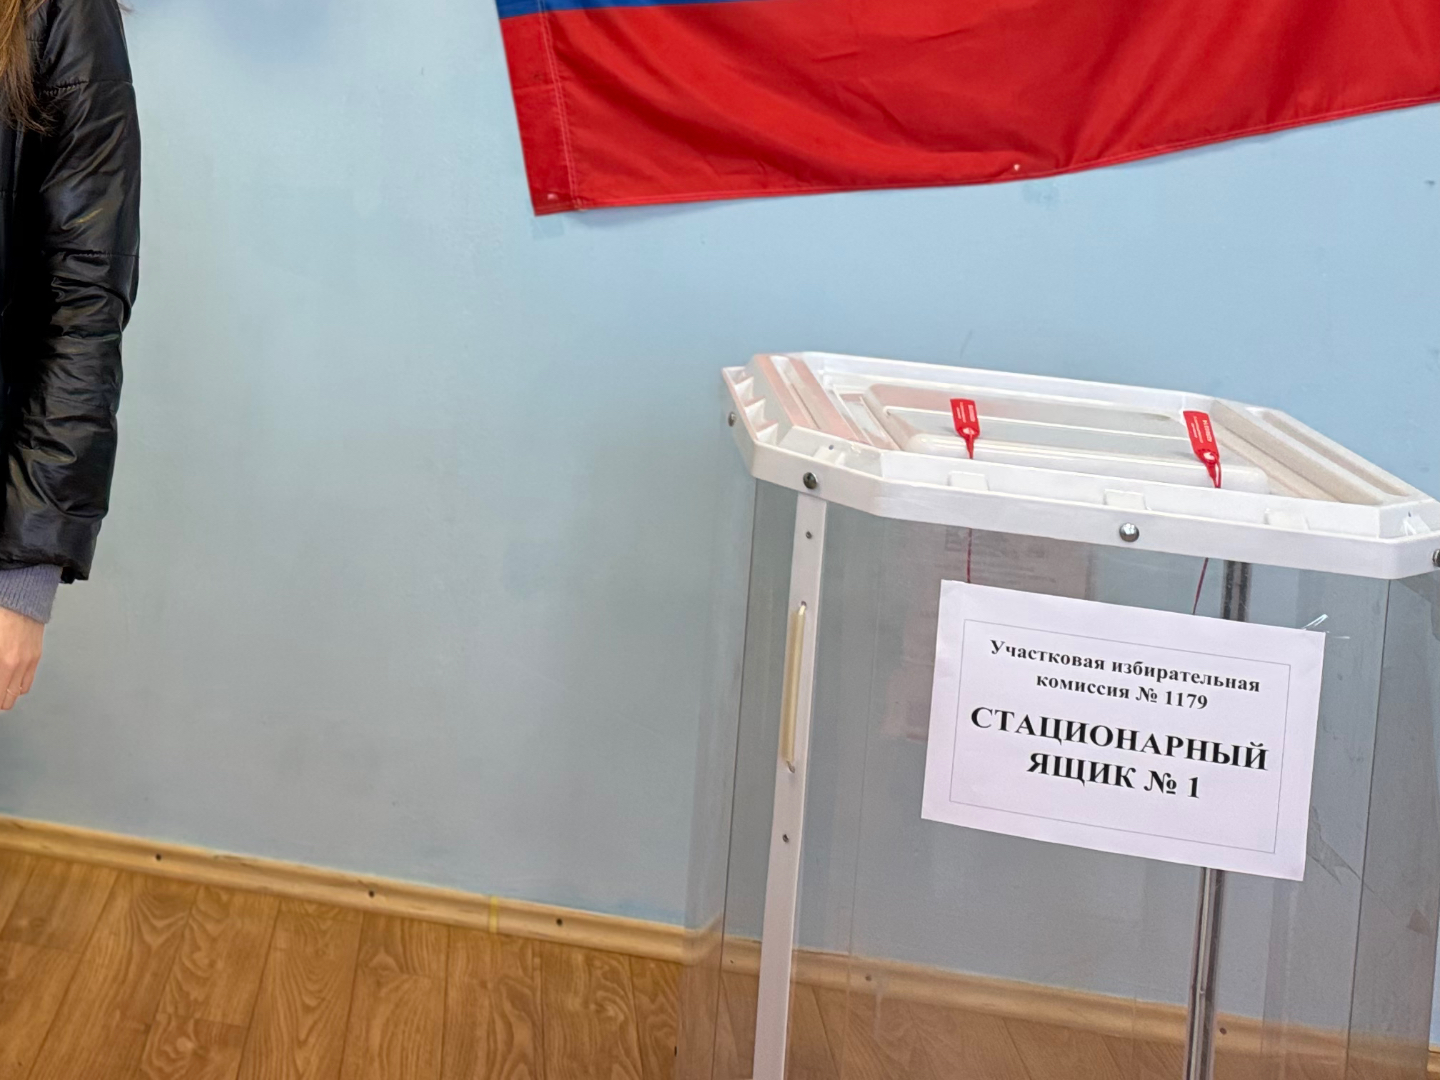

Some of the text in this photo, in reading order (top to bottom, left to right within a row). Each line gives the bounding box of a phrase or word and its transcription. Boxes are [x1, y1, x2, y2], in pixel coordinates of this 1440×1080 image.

[990, 640, 1261, 692] Участковая избирательная
[1036, 674, 1208, 709] комиссия № 1179
[971, 707, 1268, 770] СТАЦИОНАРНЫЙ
[1026, 752, 1200, 798] ЯЩИК № 1
